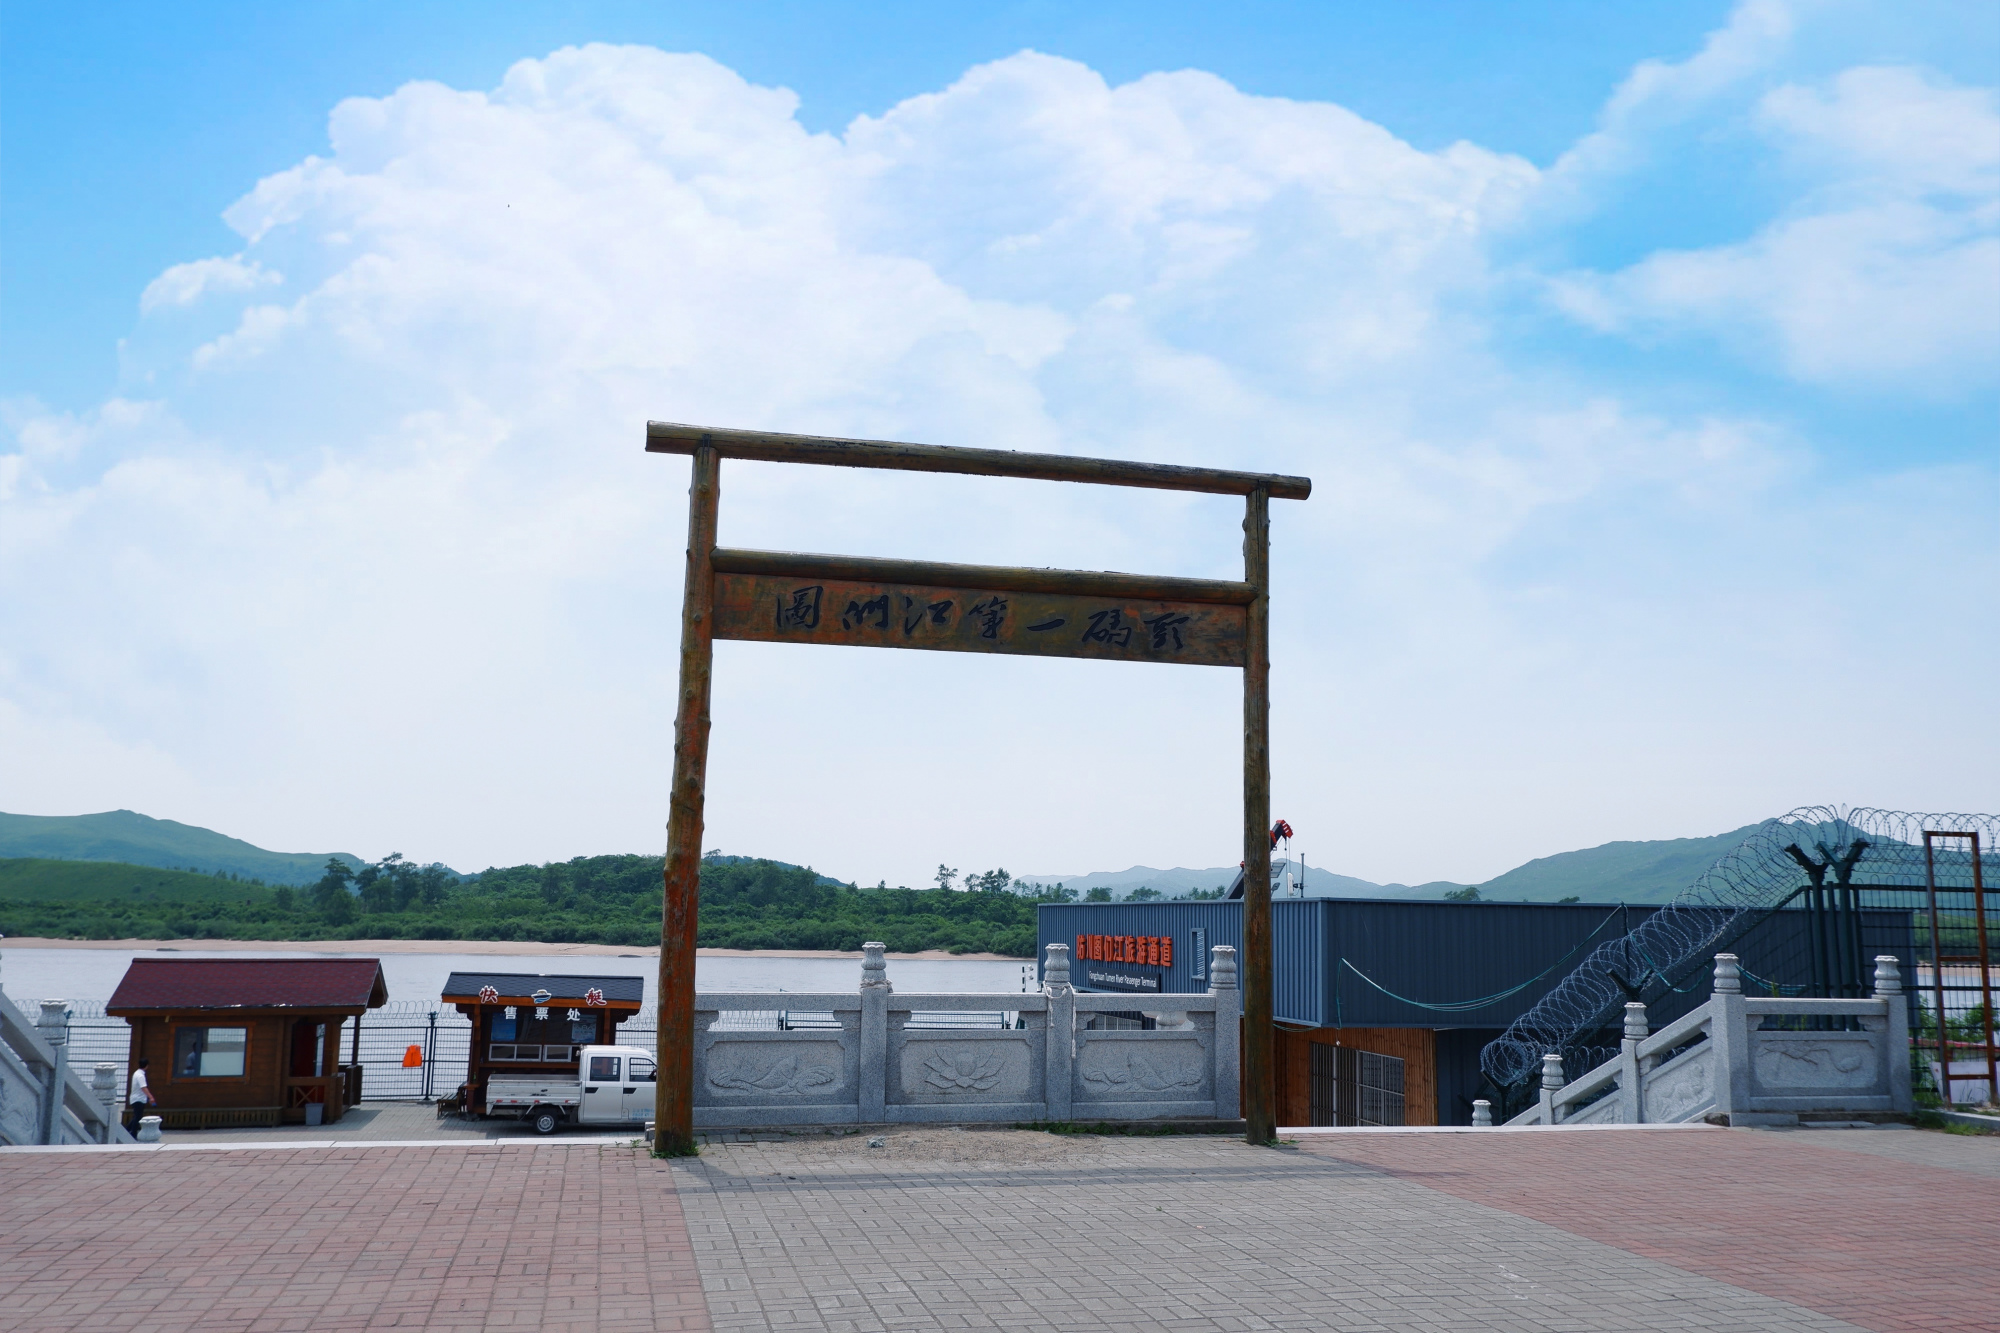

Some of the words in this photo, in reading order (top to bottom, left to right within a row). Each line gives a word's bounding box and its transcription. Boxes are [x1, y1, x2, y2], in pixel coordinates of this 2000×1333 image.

[1076, 934, 1173, 967] 防川图们江旅游通道
[1115, 974, 1125, 984] River
[1141, 976, 1157, 988] Terminal
[478, 985, 607, 1006] 快艇
[504, 1006, 581, 1021] 售票处
